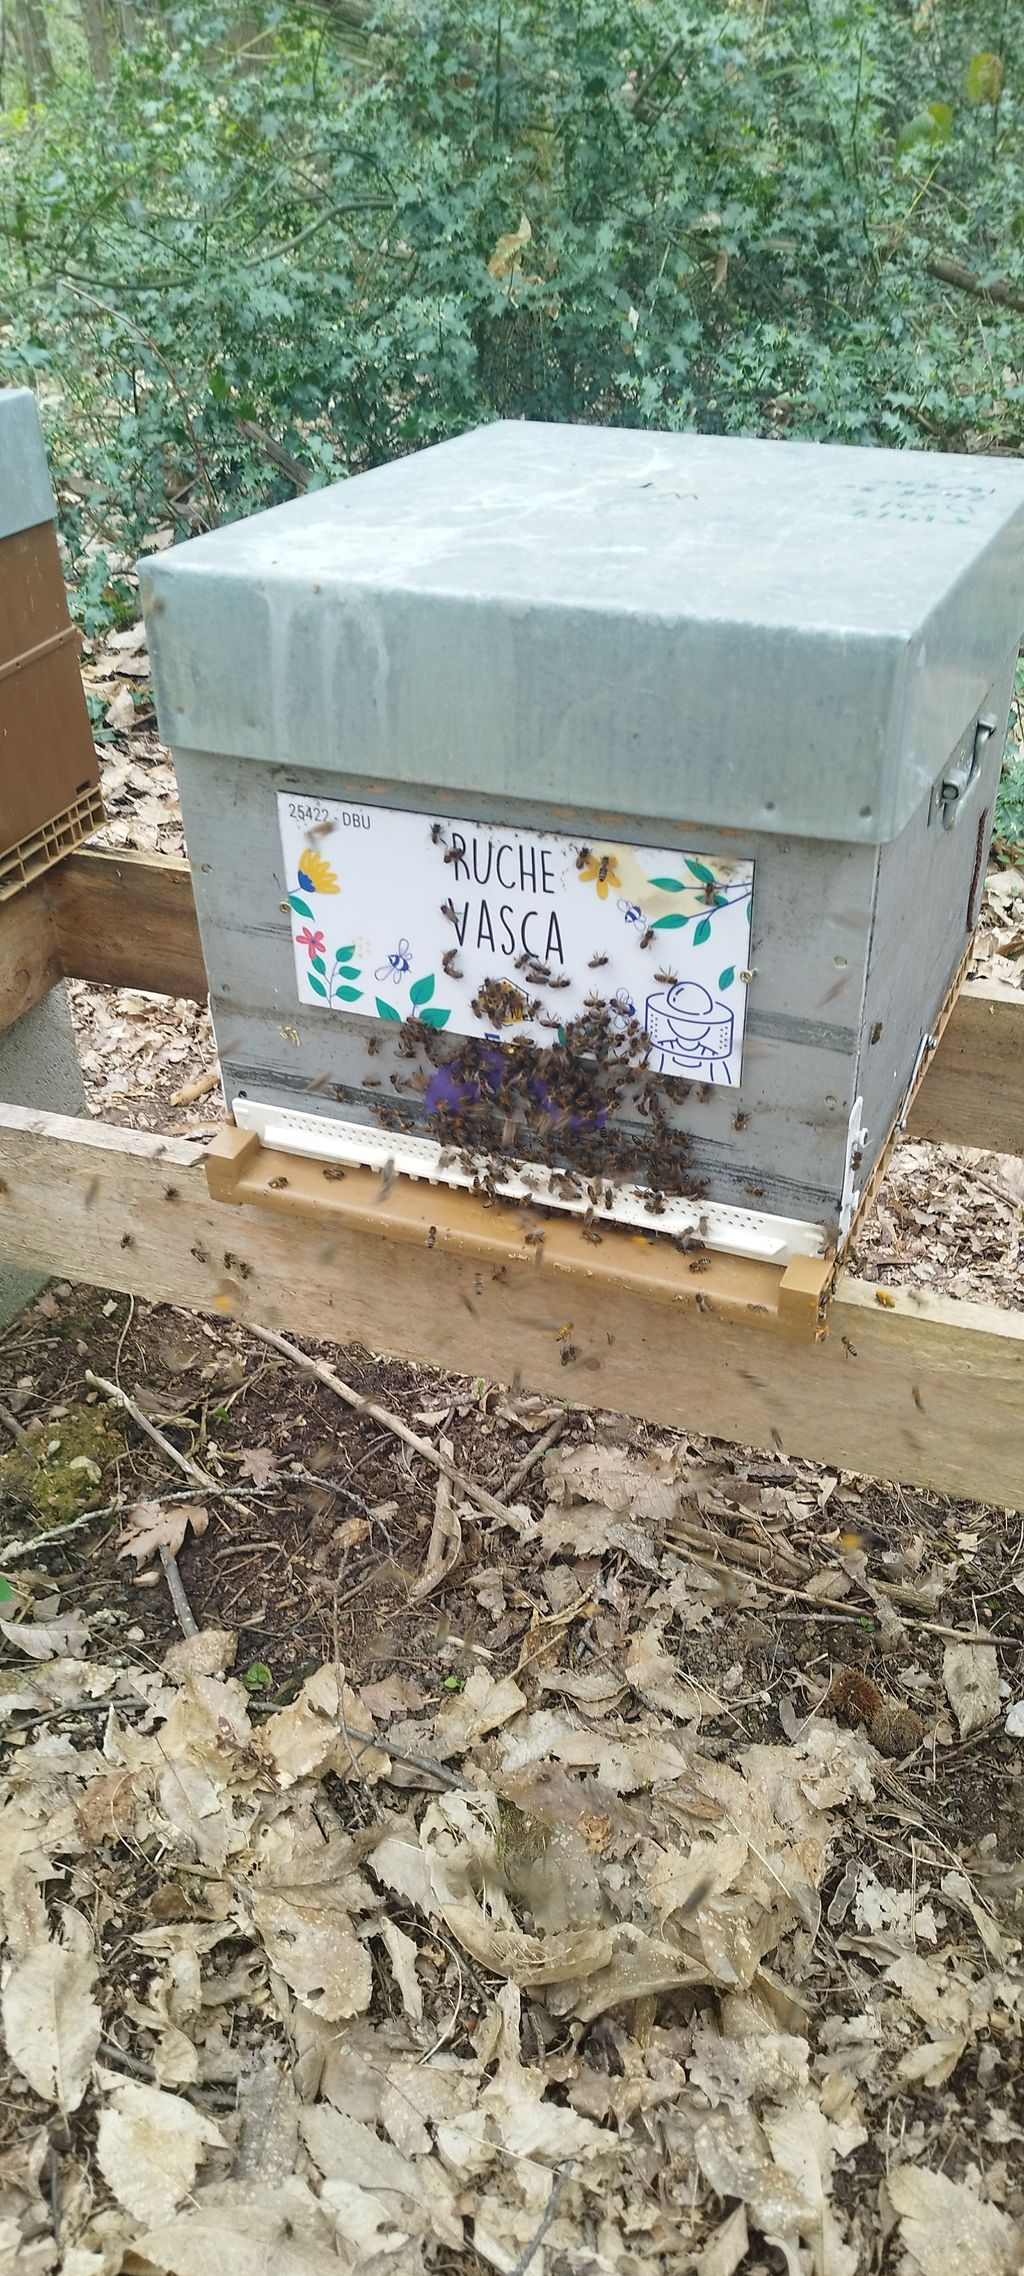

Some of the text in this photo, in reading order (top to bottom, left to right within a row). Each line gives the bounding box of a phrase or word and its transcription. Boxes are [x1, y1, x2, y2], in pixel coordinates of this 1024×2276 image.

[288, 803, 329, 823] 25422
[342, 811, 371, 830] DBU
[452, 832, 555, 893] RUCHE
[447, 897, 564, 965] VASCA
